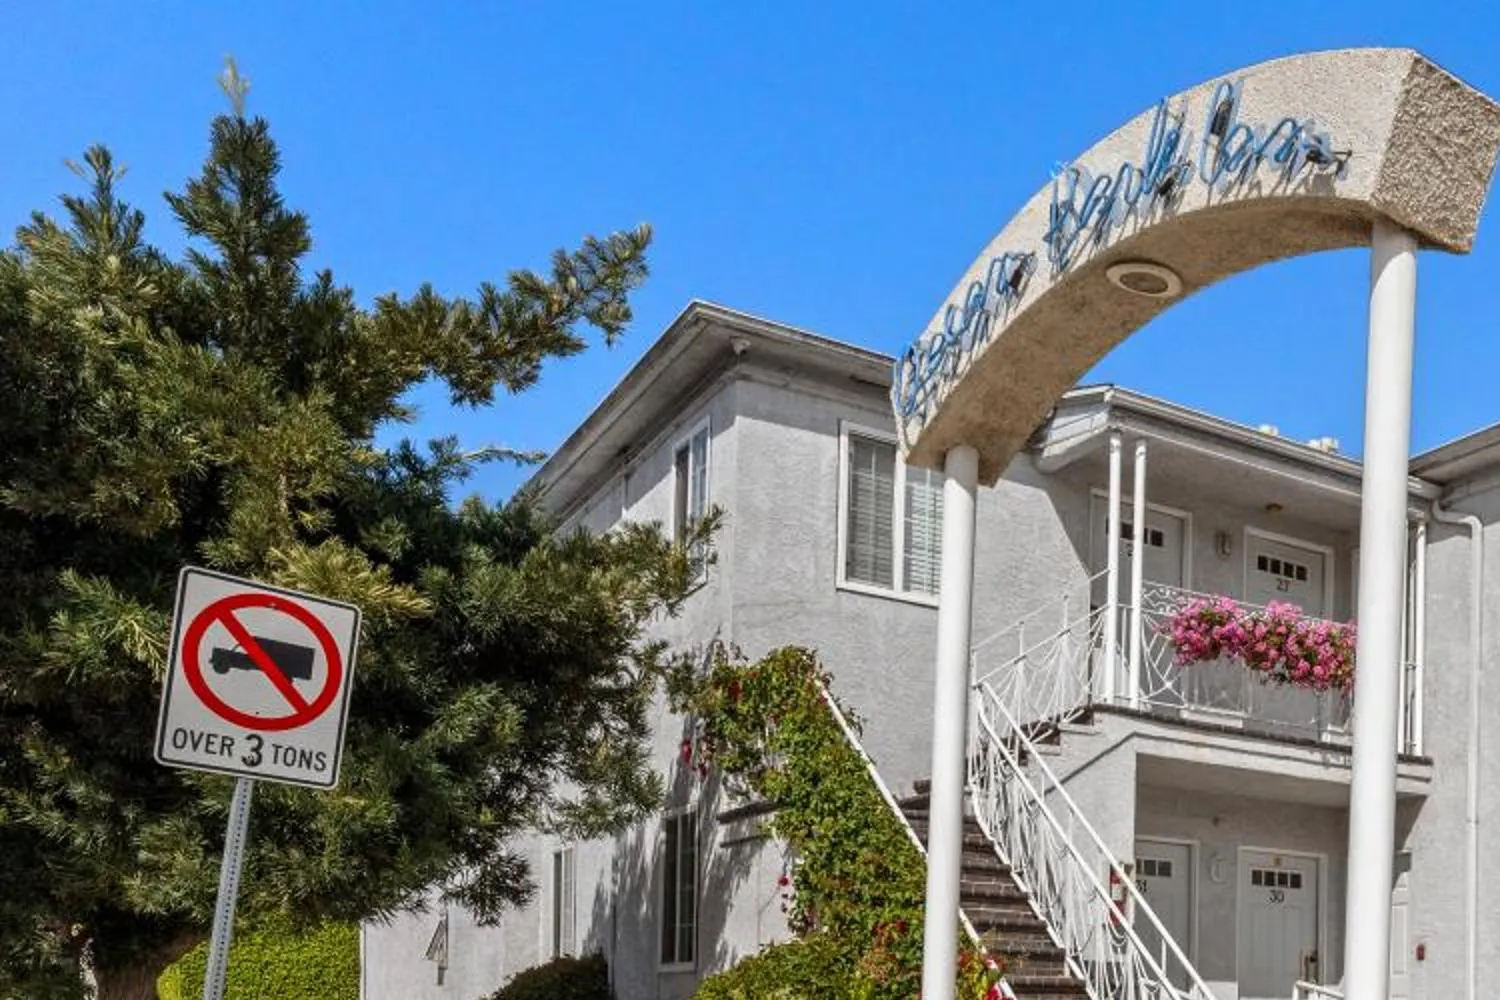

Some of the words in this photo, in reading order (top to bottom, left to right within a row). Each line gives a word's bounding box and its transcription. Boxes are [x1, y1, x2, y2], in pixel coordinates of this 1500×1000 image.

[172, 727, 235, 758] OVER
[241, 733, 265, 768] 3
[271, 743, 328, 773] TONS
